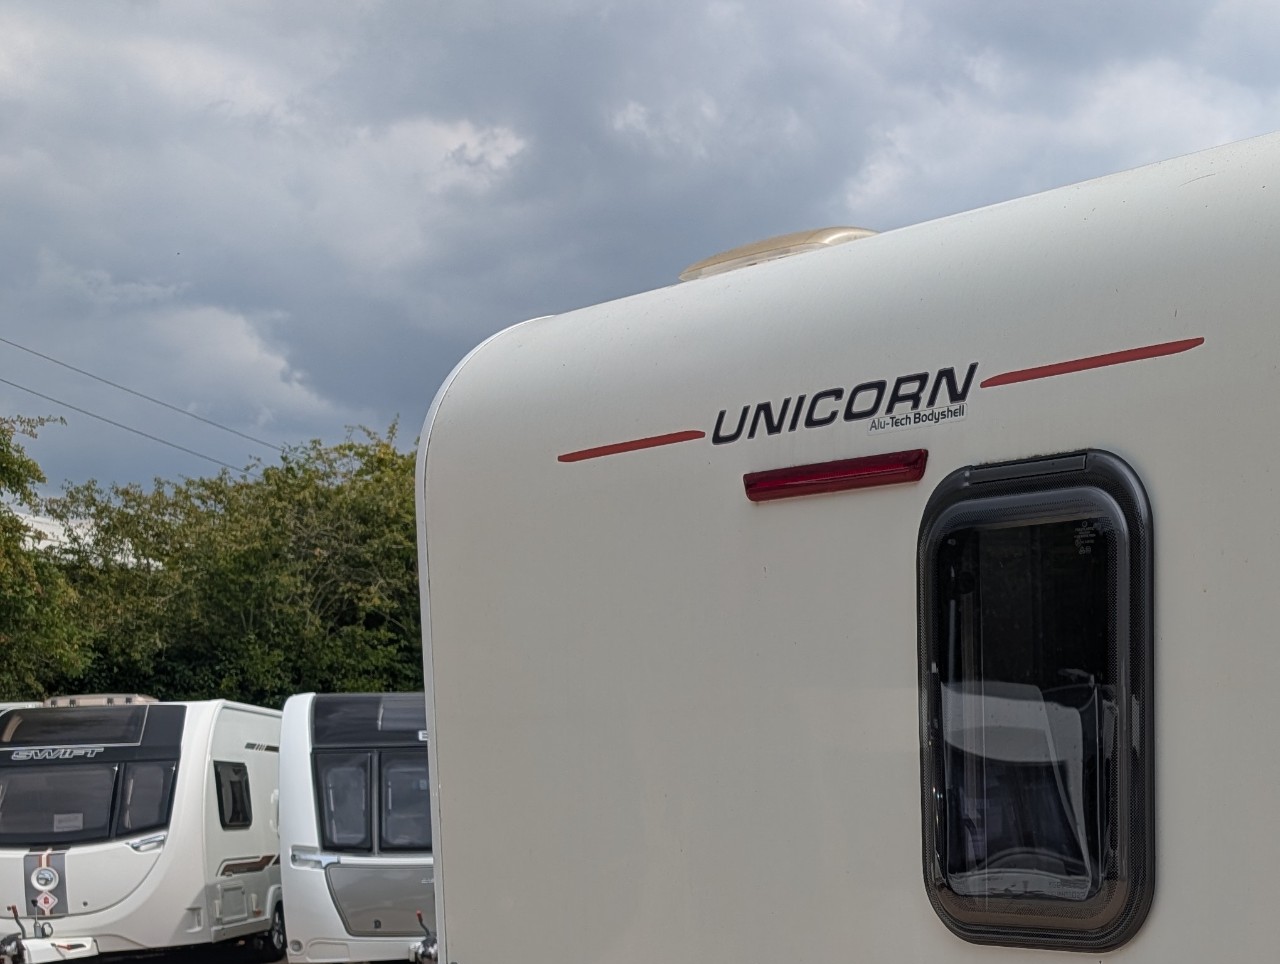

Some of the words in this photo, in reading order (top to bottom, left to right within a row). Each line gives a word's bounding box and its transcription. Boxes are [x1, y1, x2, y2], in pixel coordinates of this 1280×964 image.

[712, 362, 979, 445] UNICORN
[870, 415, 911, 431] Alu-Tech
[913, 404, 965, 424] Bodyshell
[11, 747, 104, 760] SWIFT
